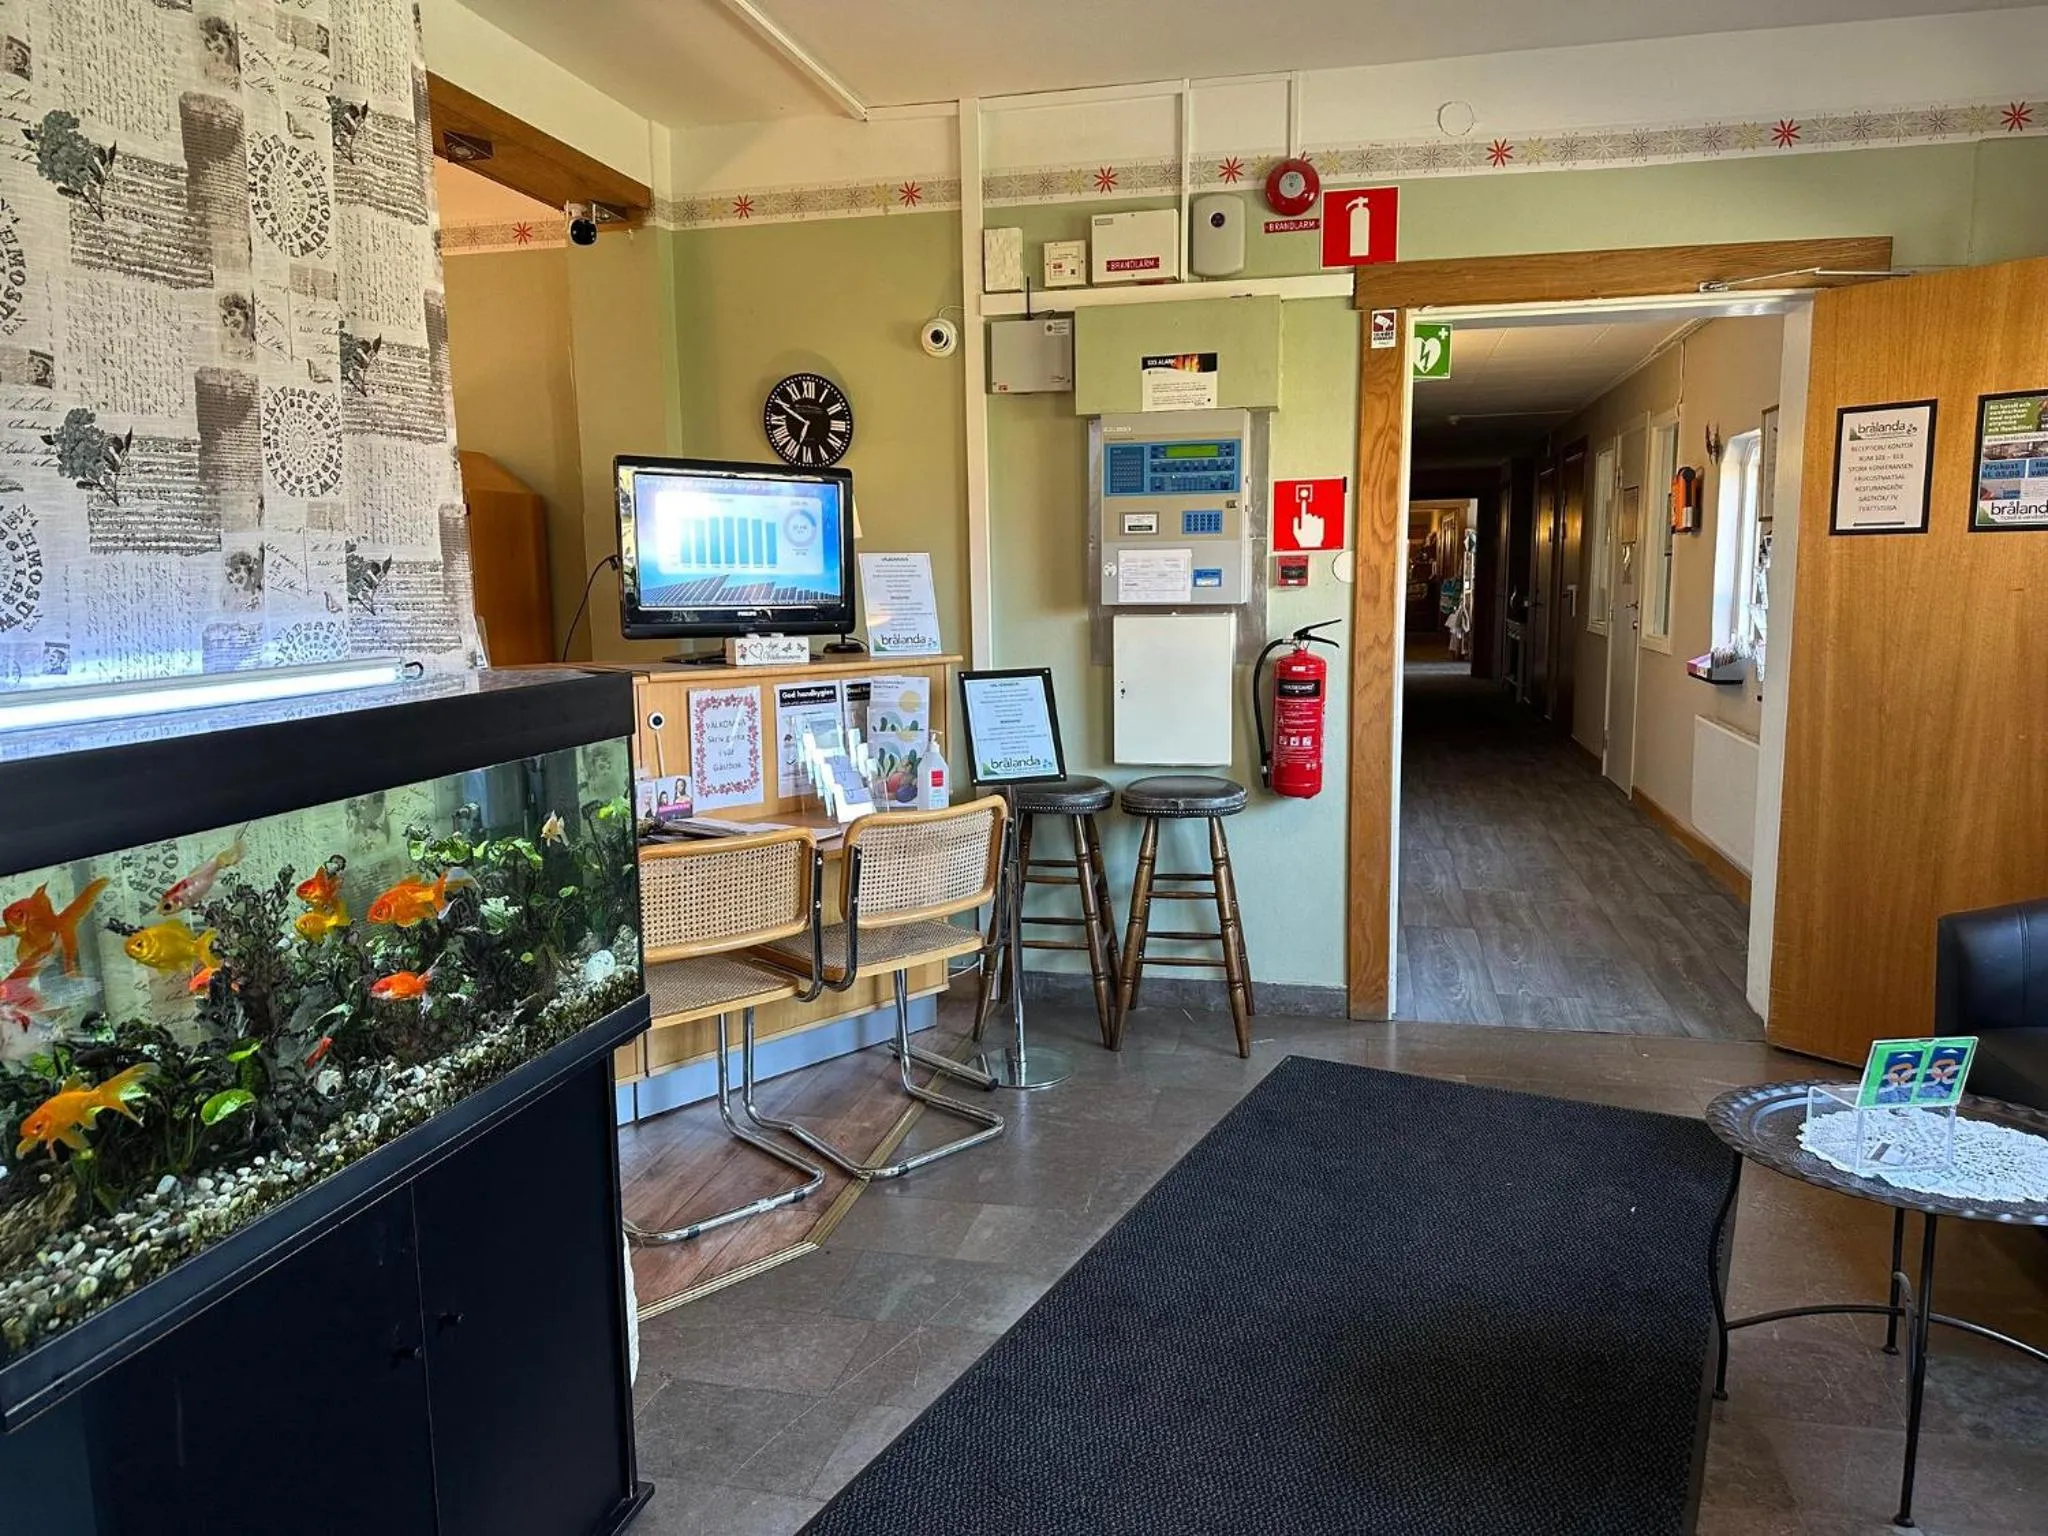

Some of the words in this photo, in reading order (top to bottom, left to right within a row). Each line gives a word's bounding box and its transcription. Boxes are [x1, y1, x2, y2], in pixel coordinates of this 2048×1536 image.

[1268, 220, 1315, 231] BRANDLARM
[1110, 259, 1155, 270] BRANDLARM
[1857, 420, 1906, 434] brålanda
[880, 633, 926, 645] brålanda
[781, 690, 796, 699] God
[726, 734, 745, 743] grna
[990, 755, 1040, 769] brålanda
